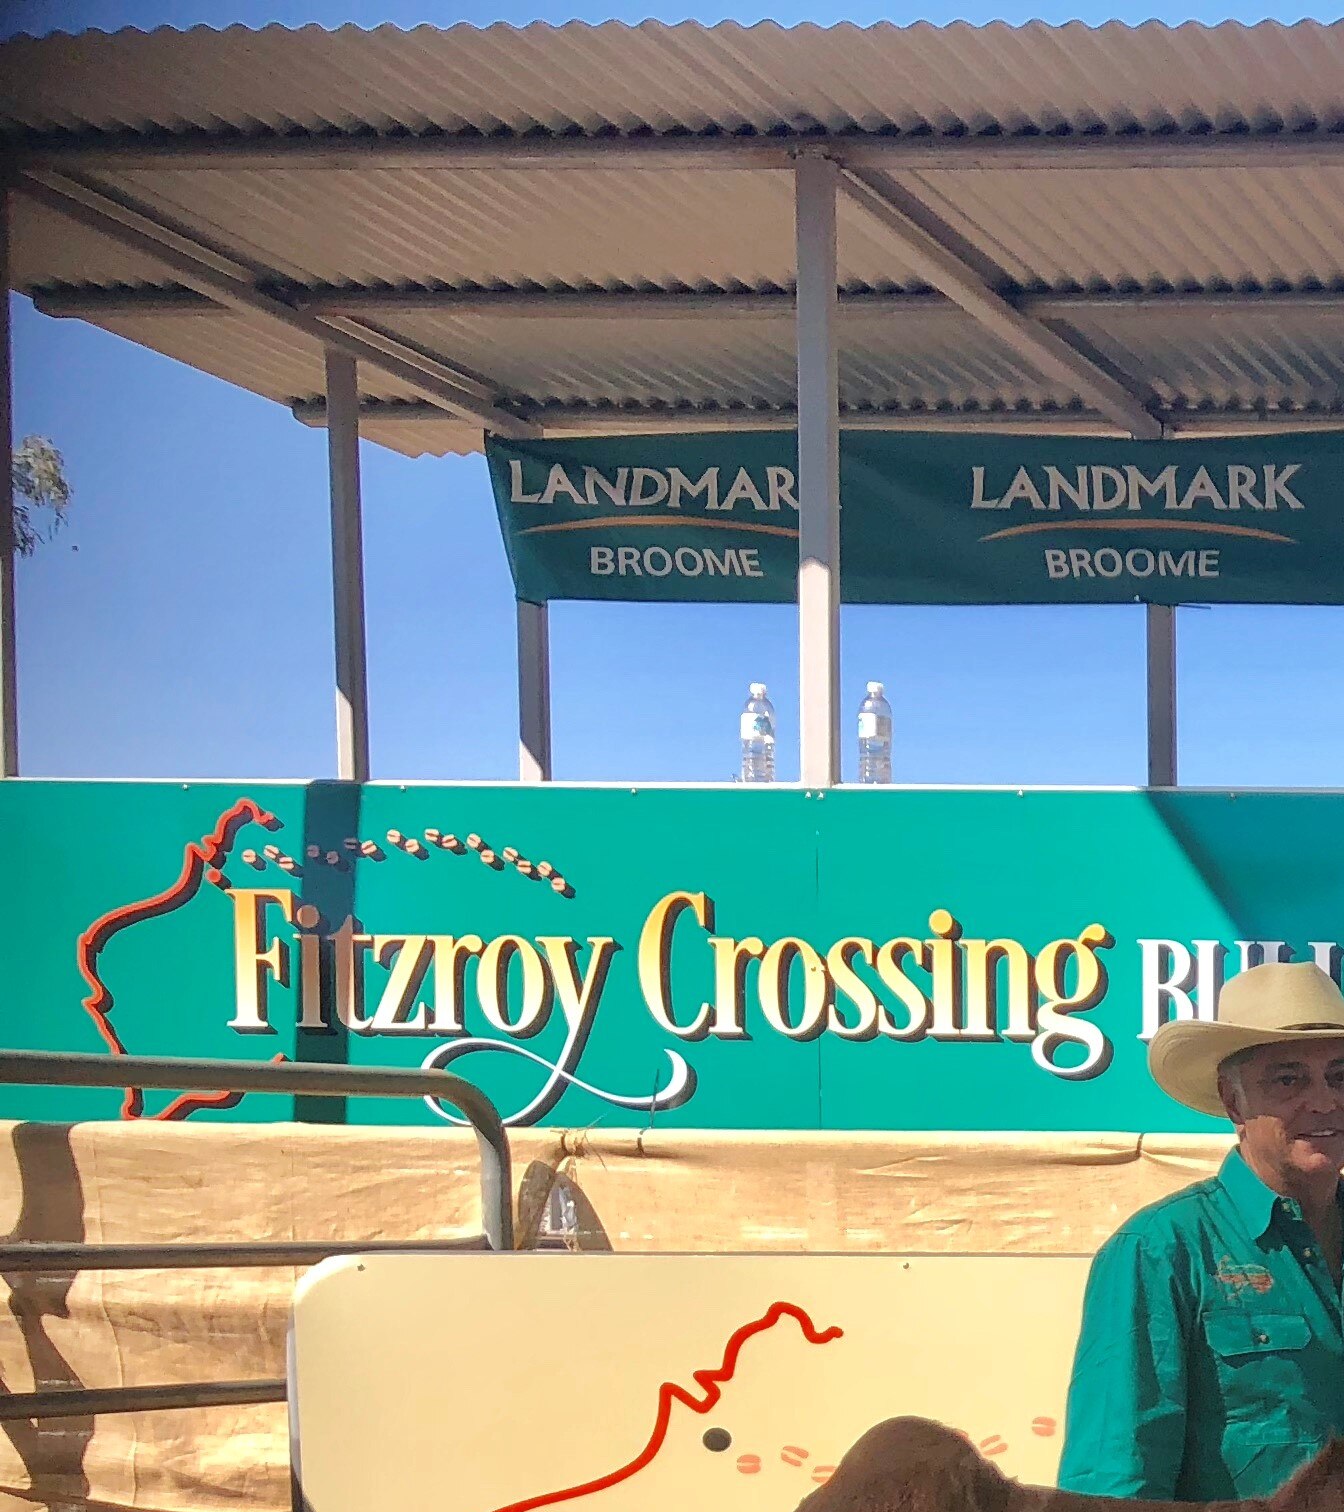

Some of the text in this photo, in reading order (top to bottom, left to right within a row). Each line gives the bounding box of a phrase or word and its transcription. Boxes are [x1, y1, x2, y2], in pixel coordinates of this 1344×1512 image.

[508, 459, 842, 511] LANDMAR
[970, 464, 1305, 511] LANDMARK
[589, 546, 764, 578] BROOME
[1044, 547, 1221, 579] BROOME
[226, 888, 640, 1124] Fitzroy
[637, 889, 1112, 1080] Crossing
